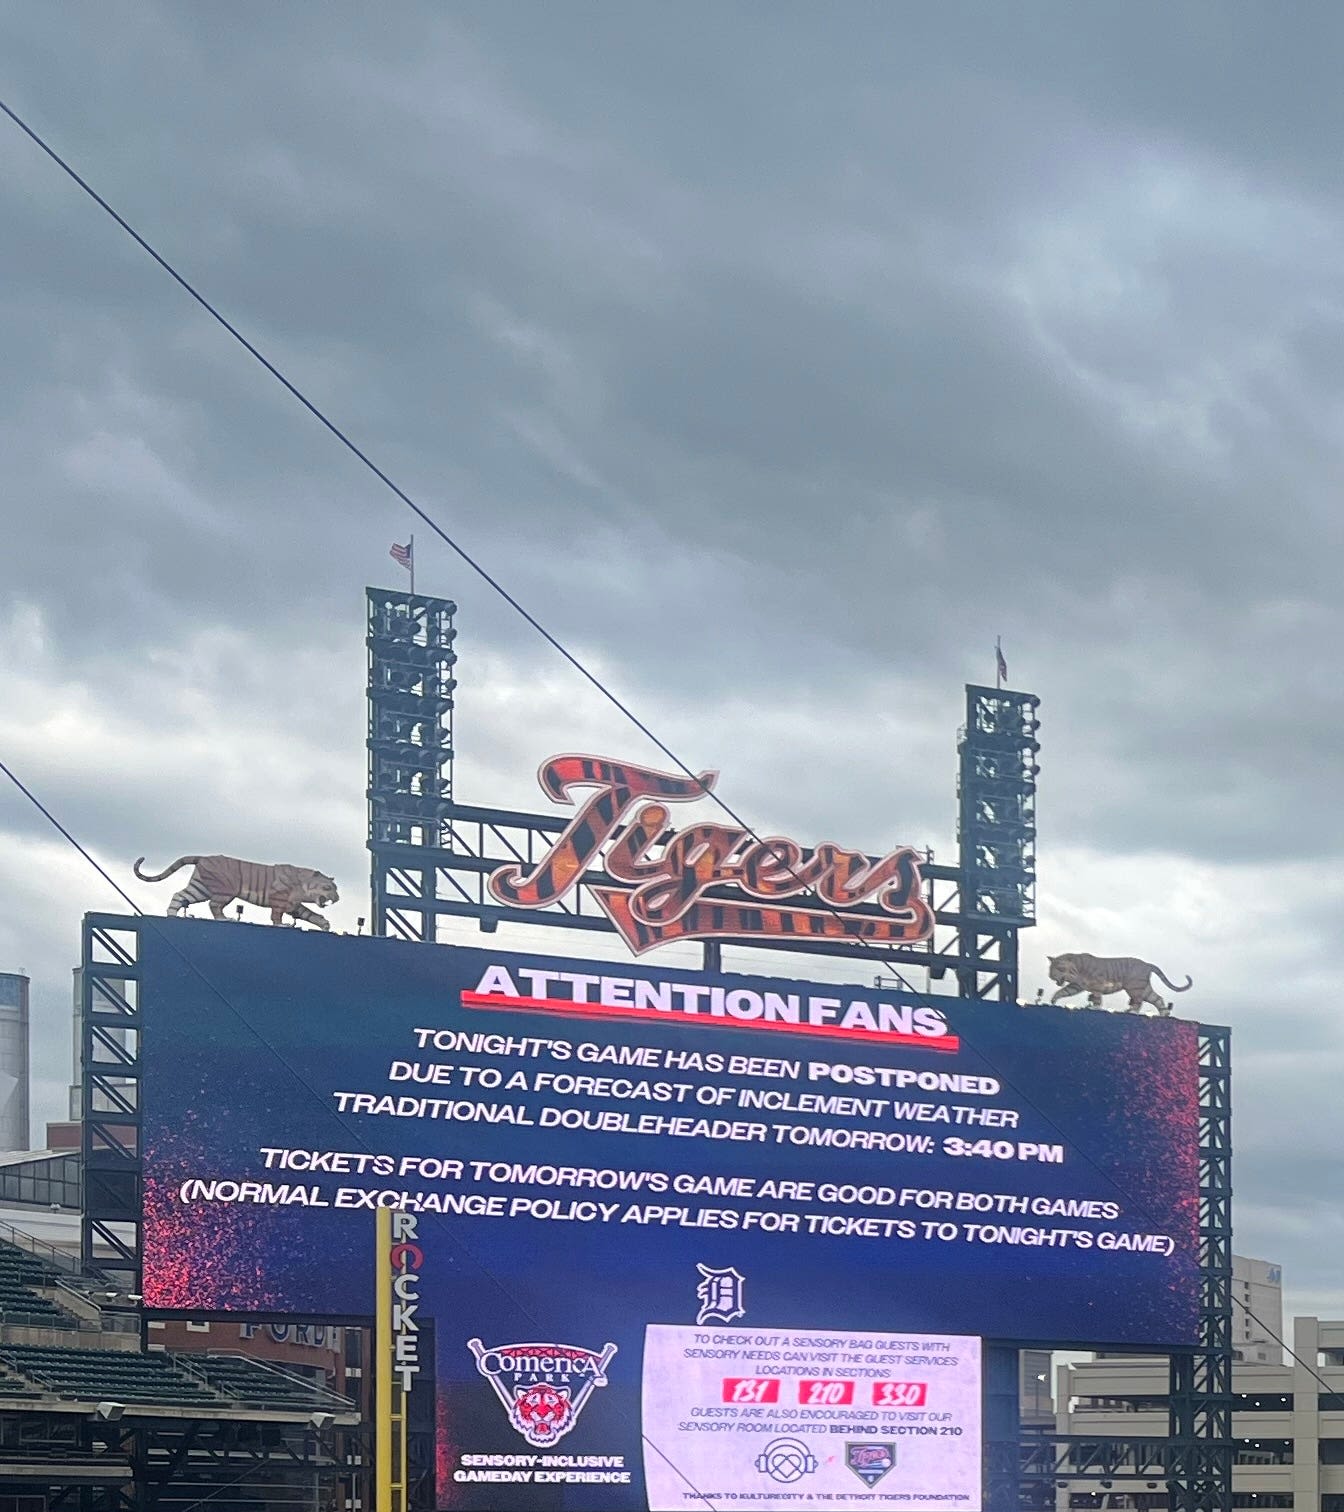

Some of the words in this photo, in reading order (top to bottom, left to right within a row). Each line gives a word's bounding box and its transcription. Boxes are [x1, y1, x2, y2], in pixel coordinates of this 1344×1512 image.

[488, 752, 936, 956] Tigers
[475, 965, 801, 1024] ATTENTION
[808, 993, 948, 1036] FANS
[413, 1027, 571, 1062] TONIGHT'S
[577, 1041, 662, 1070] GAME
[664, 1048, 724, 1075] HAS
[728, 1053, 800, 1081] BEEN
[808, 1060, 999, 1098] POSTPONED
[389, 1060, 453, 1087] DUE
[460, 1066, 502, 1091] TO
[505, 1070, 529, 1093] A
[533, 1072, 690, 1106] FORECAST
[697, 1085, 734, 1109] OF
[738, 1088, 888, 1121] INCLEMENT
[893, 1100, 1019, 1132] WEATHER
[333, 1091, 533, 1127] TRADITIONAL
[539, 1106, 766, 1144] DOUBLEHEADER
[772, 1122, 935, 1156] TOMORROW:
[943, 1135, 1013, 1162] 3:40
[1017, 1140, 1064, 1165] PM
[259, 1147, 393, 1177] TICKETS
[399, 1156, 463, 1182] FOR
[470, 1160, 667, 1195] TOMORROW'S
[673, 1173, 754, 1200] GAME
[757, 1178, 814, 1204] ARE
[817, 1182, 895, 1209] GOOD
[900, 1187, 957, 1213] FOR
[961, 1191, 1029, 1217] BOTH
[1032, 1195, 1119, 1223] GAMES
[180, 1178, 328, 1211] (NORMAL
[334, 1187, 504, 1221] EXCHANGE
[510, 1198, 618, 1228] POLICY
[621, 1204, 738, 1235] APPLIES
[743, 1211, 799, 1239] FOR
[804, 1215, 915, 1245] TICKETS
[921, 1222, 957, 1248] TO
[964, 1224, 1093, 1256] TONIGHT'S
[1097, 1232, 1174, 1261] GAME)
[694, 1332, 710, 1346] TO
[712, 1333, 753, 1348] CHECK
[755, 1335, 780, 1349] OUT
[782, 1336, 790, 1349] A
[792, 1336, 848, 1351] SENSORY
[849, 1338, 874, 1352] BAG
[875, 1339, 920, 1354] GUESTS
[922, 1341, 950, 1355] WITH
[683, 1348, 740, 1361] SENSORY
[742, 1349, 780, 1363] NEEDS
[783, 1351, 808, 1363] CAN
[809, 1351, 838, 1364] VISIT
[841, 1352, 863, 1365] THE
[865, 1353, 902, 1366] GUEST
[904, 1354, 959, 1368] SERVICES
[514, 1373, 570, 1382] PARK
[755, 1364, 820, 1378] LOCATIONS
[822, 1366, 834, 1378] IN
[835, 1366, 891, 1379] SECTIONS
[732, 1380, 768, 1402] 131
[807, 1382, 844, 1404] 210
[878, 1384, 920, 1405] 330
[461, 1454, 625, 1468] SENSORY-INCLUSIVE
[453, 1470, 534, 1483] GAMEDAY
[535, 1471, 631, 1484] EXPERIENCE
